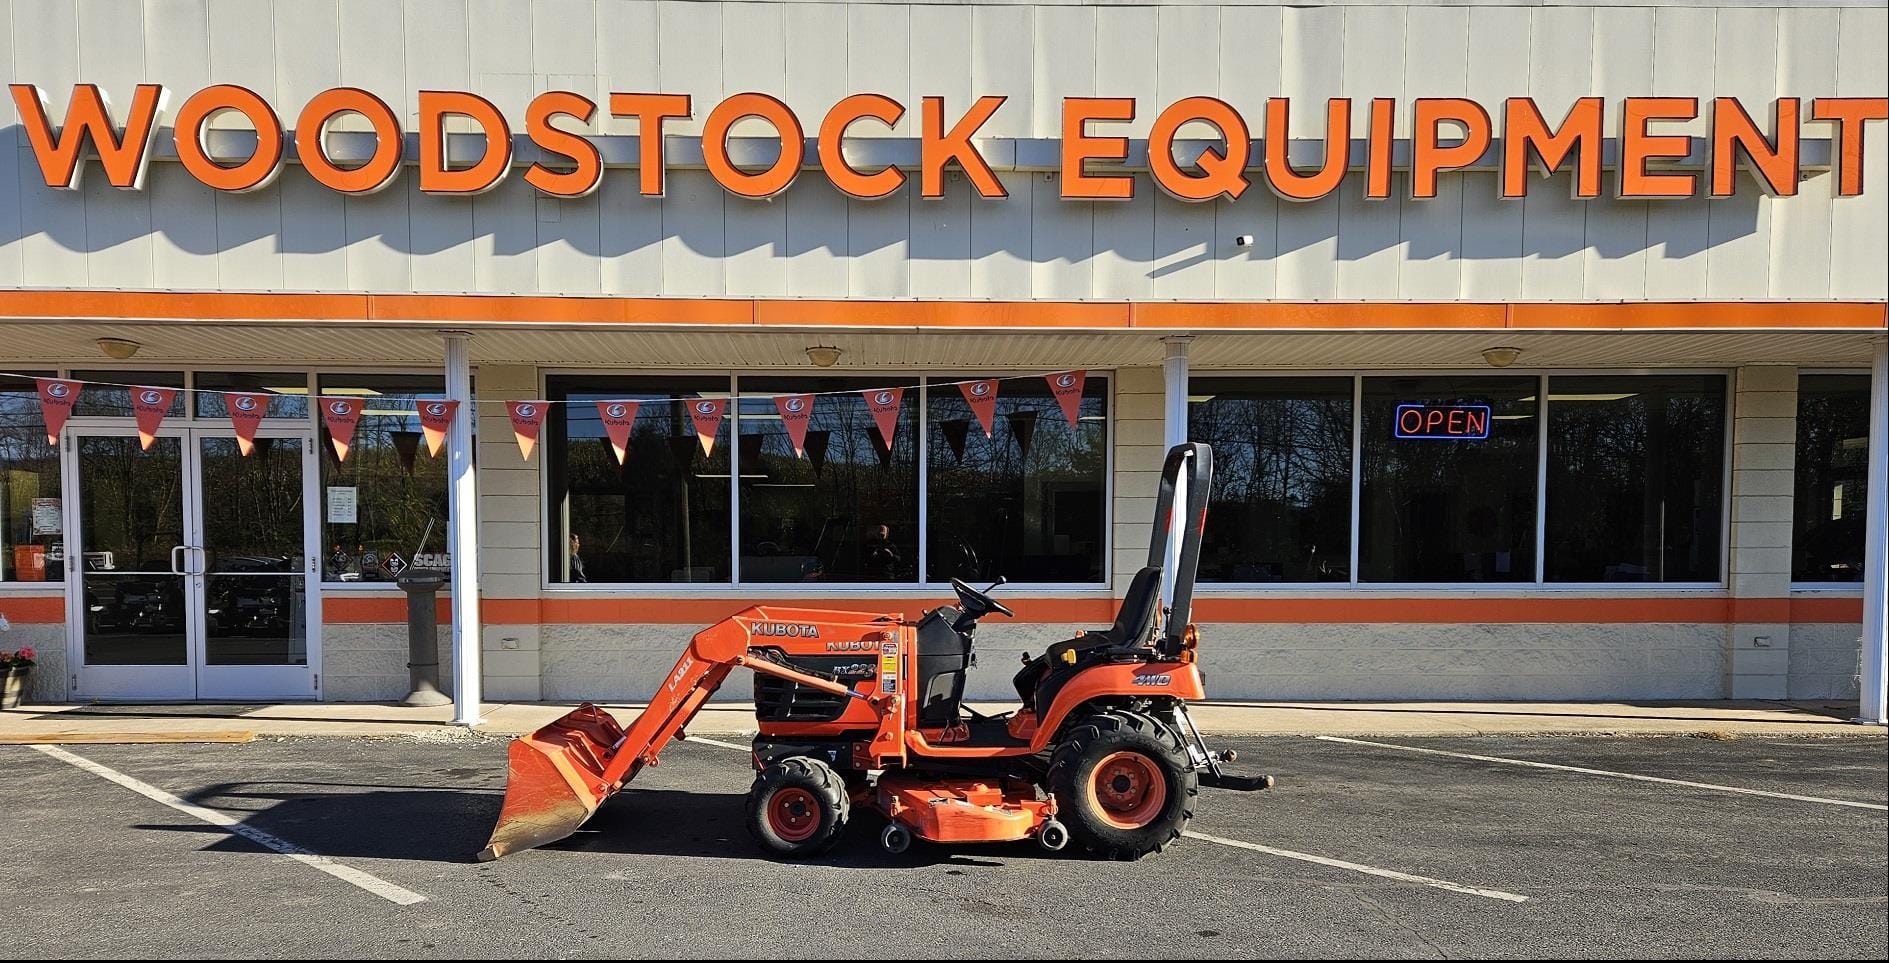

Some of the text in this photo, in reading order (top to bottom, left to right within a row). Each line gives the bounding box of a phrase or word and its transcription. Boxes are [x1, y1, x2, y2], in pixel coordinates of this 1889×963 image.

[10, 83, 1888, 200] WOODSTOCK EQUIPMENT
[1056, 387, 1080, 397] Kubota
[44, 398, 71, 407] Kubota
[969, 395, 995, 404] Kubota
[136, 405, 164, 414] Kubota
[873, 406, 898, 414] Kubota
[233, 411, 260, 420] Kubota
[327, 415, 355, 424] Kubota
[423, 415, 449, 424] Kubota
[694, 414, 719, 422] Kubota
[784, 413, 808, 421] Kubota
[512, 418, 539, 427] Kubota
[605, 418, 631, 427] Kubota
[1400, 409, 1485, 434] OPEN
[413, 553, 451, 567] SCAG
[751, 621, 820, 638] KUBOTA
[1132, 674, 1171, 686] 4WD
